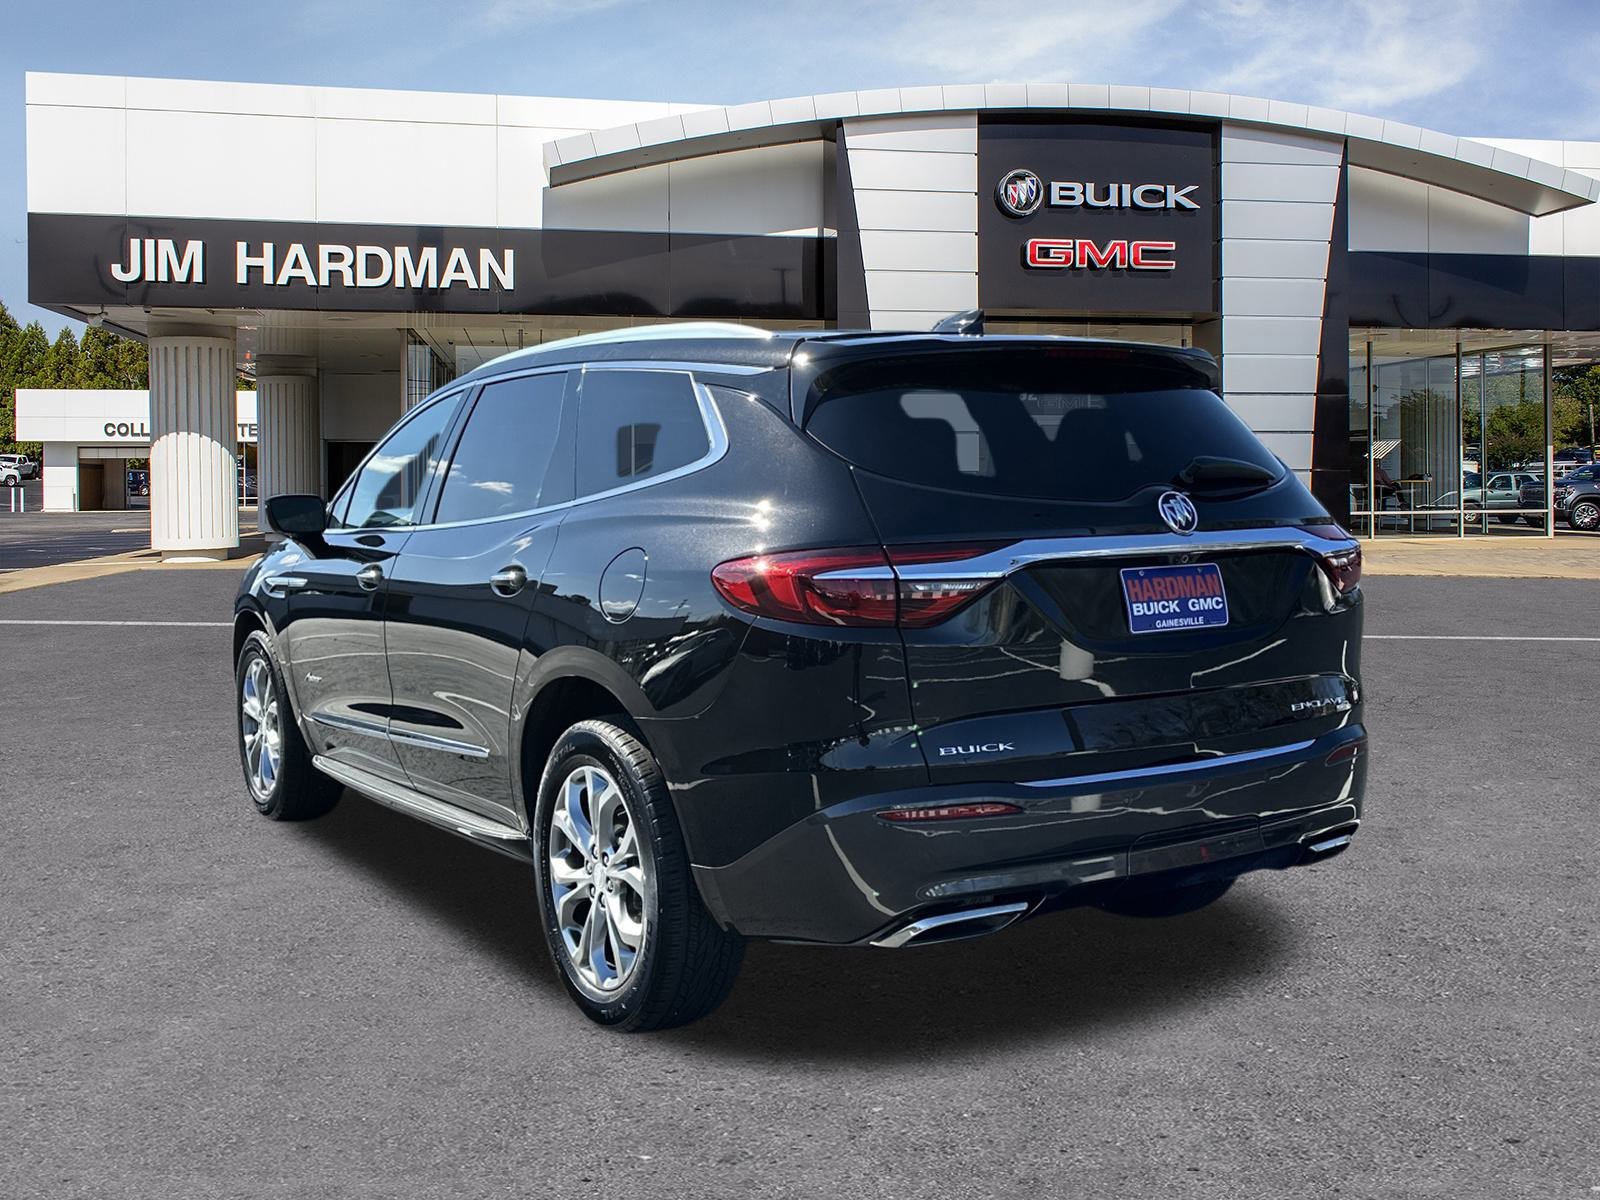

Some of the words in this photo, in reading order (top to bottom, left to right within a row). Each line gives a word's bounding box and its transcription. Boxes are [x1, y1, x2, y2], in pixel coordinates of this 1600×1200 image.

[1050, 181, 1201, 209] BUICK
[111, 238, 205, 283] JIM
[236, 241, 515, 290] HARDMAN
[1027, 238, 1176, 270] GMC
[1127, 574, 1221, 602] HARDMAN
[1131, 600, 1181, 616] BUICK
[1188, 596, 1224, 611] GMC
[1155, 616, 1204, 629] GAINESVILLE
[939, 742, 1016, 756] BUICK
